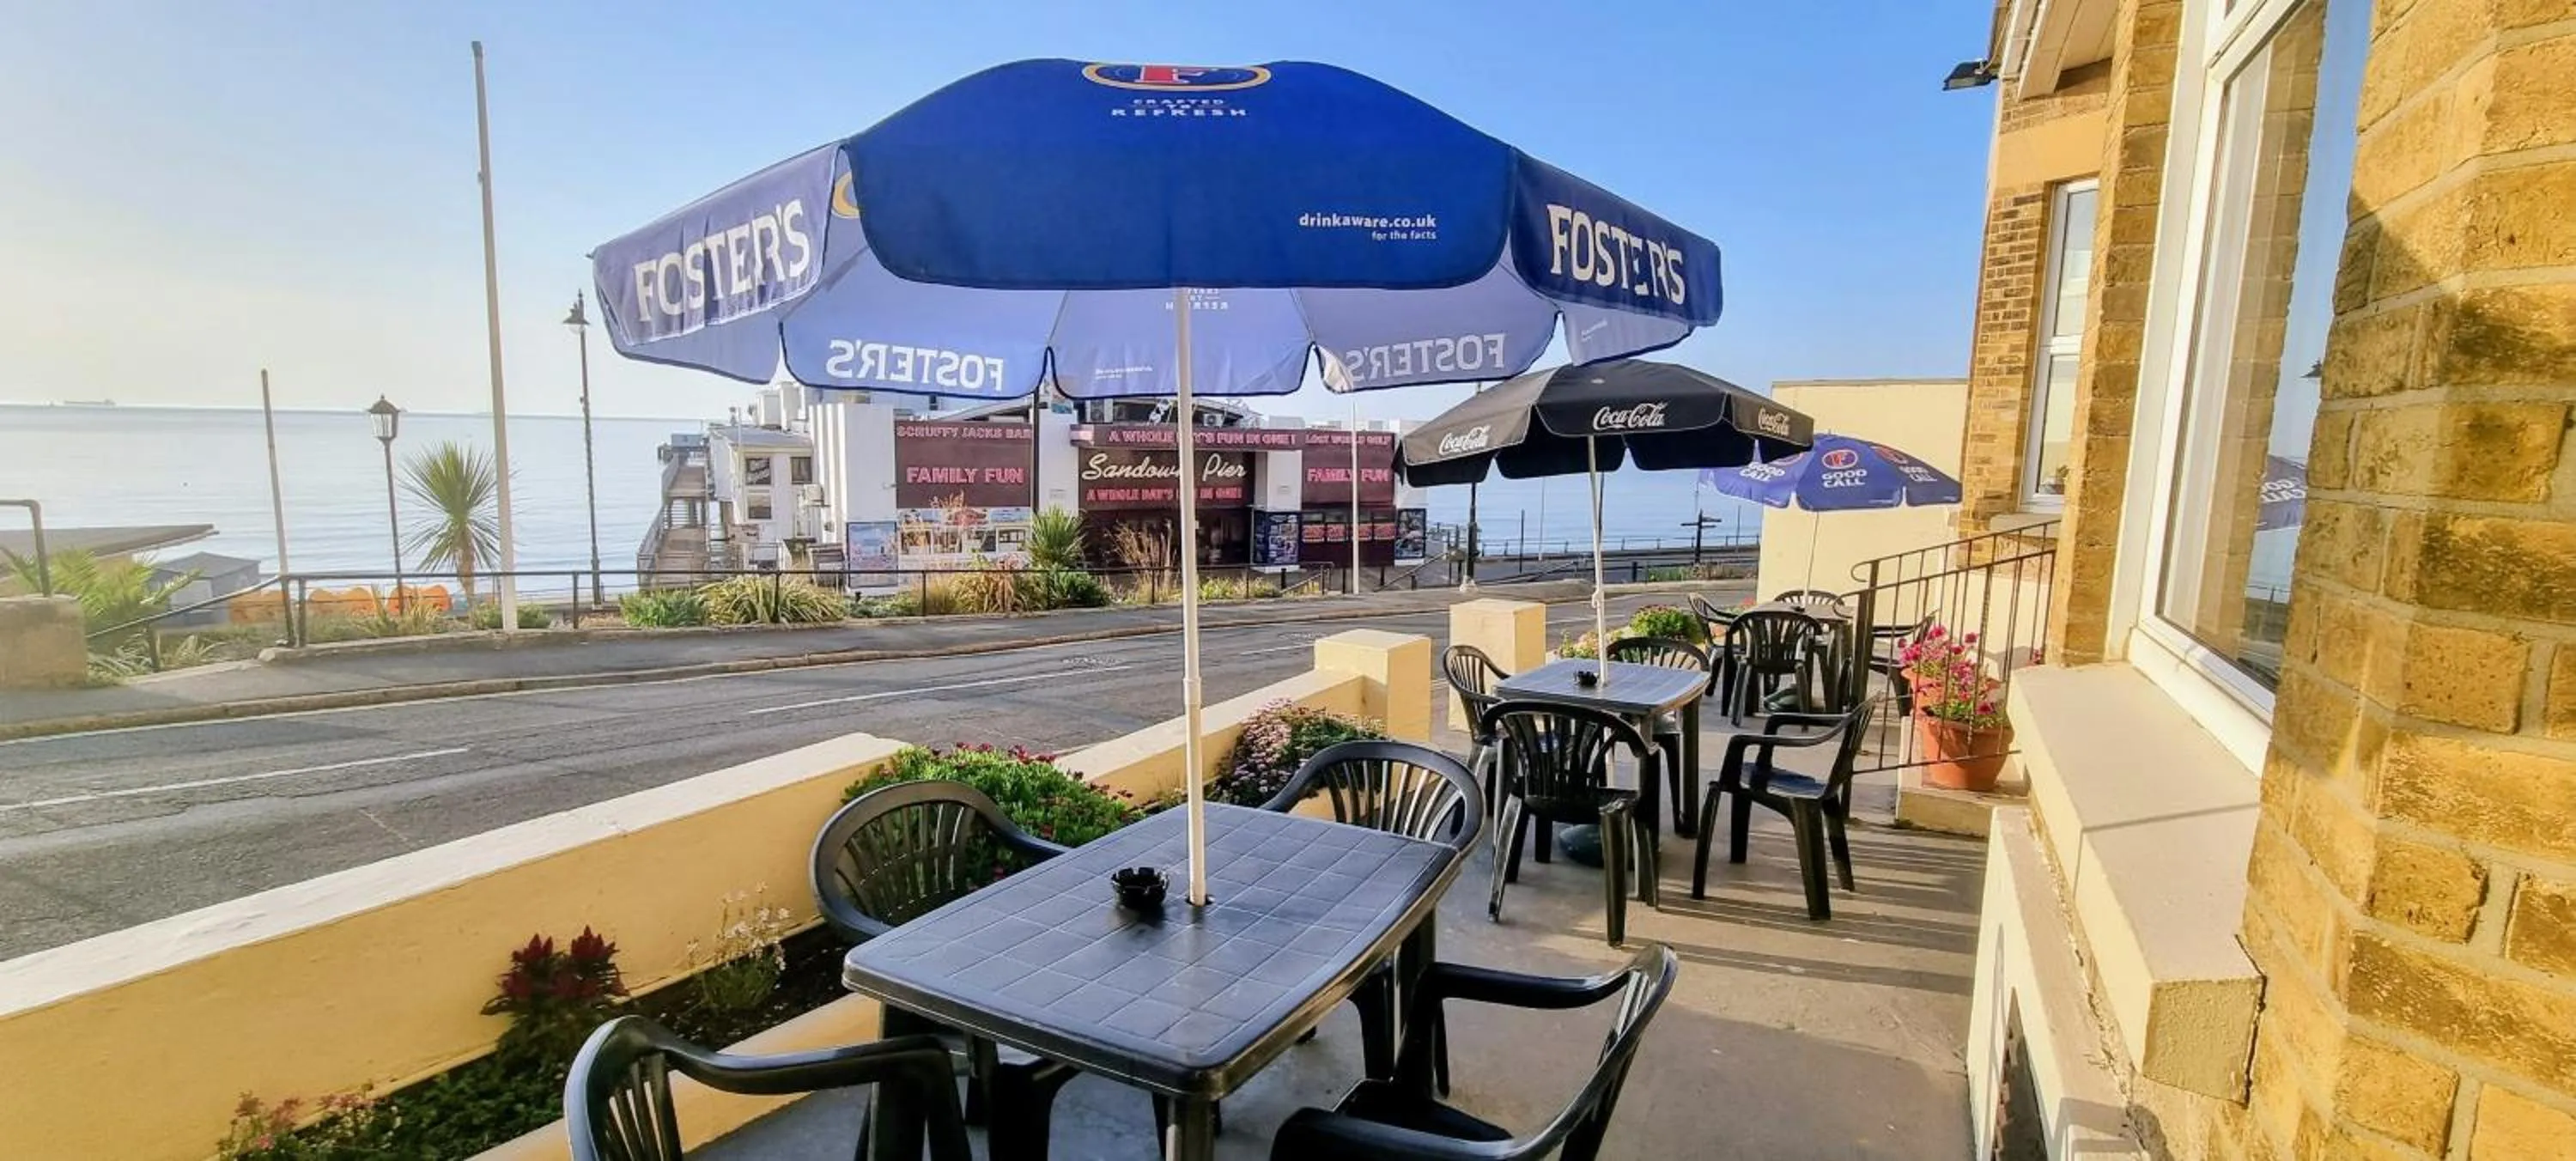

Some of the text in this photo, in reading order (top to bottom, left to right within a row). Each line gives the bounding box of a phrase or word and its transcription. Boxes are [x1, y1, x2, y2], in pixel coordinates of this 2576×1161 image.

[1298, 213, 1437, 228] drinkaware.co.uk
[1372, 229, 1437, 241] for the facts
[633, 198, 811, 322] FOSTER'S
[1547, 204, 1686, 305] FOSTER'S
[1593, 401, 1668, 430] Coca-Cola
[896, 425, 958, 439] SCRUFFY
[961, 427, 1003, 439] JACKS
[1109, 431, 1118, 442] A
[1122, 431, 1174, 443] WHOLE
[1217, 433, 1244, 444] FUN
[1246, 434, 1261, 444] IN
[1438, 425, 1492, 456] Coca-Cola
[1202, 453, 1247, 481] Pier
[1821, 469, 1868, 480] GOOD
[906, 466, 1025, 484] FAMILY FUN
[1361, 469, 1389, 482] FUN
[1823, 477, 1866, 488] CALL
